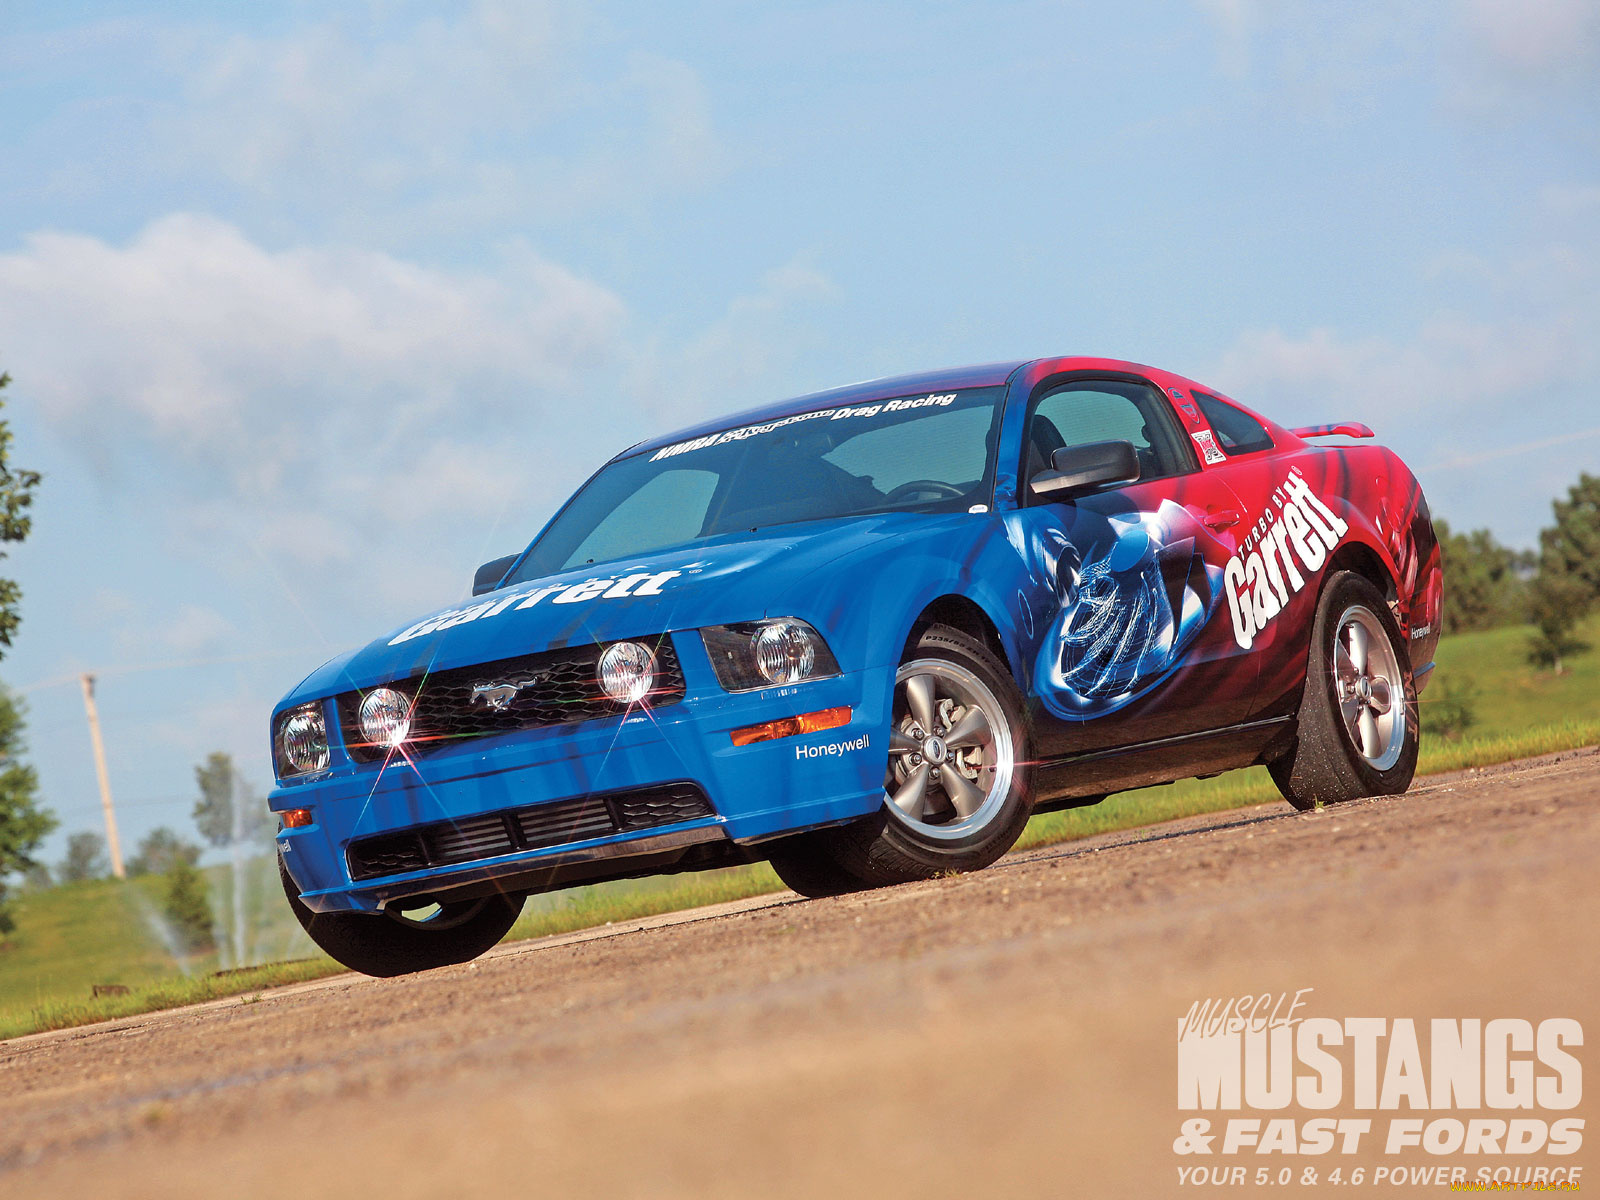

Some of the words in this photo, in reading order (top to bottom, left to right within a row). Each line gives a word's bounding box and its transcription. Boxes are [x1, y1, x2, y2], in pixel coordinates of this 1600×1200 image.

[831, 401, 882, 421] Drag
[882, 393, 958, 413] Racing
[1238, 507, 1274, 560] TURBO
[1272, 486, 1287, 509] BY
[1224, 471, 1349, 650] Garrett
[387, 570, 683, 646] Garrett
[796, 734, 870, 760] Honeywell
